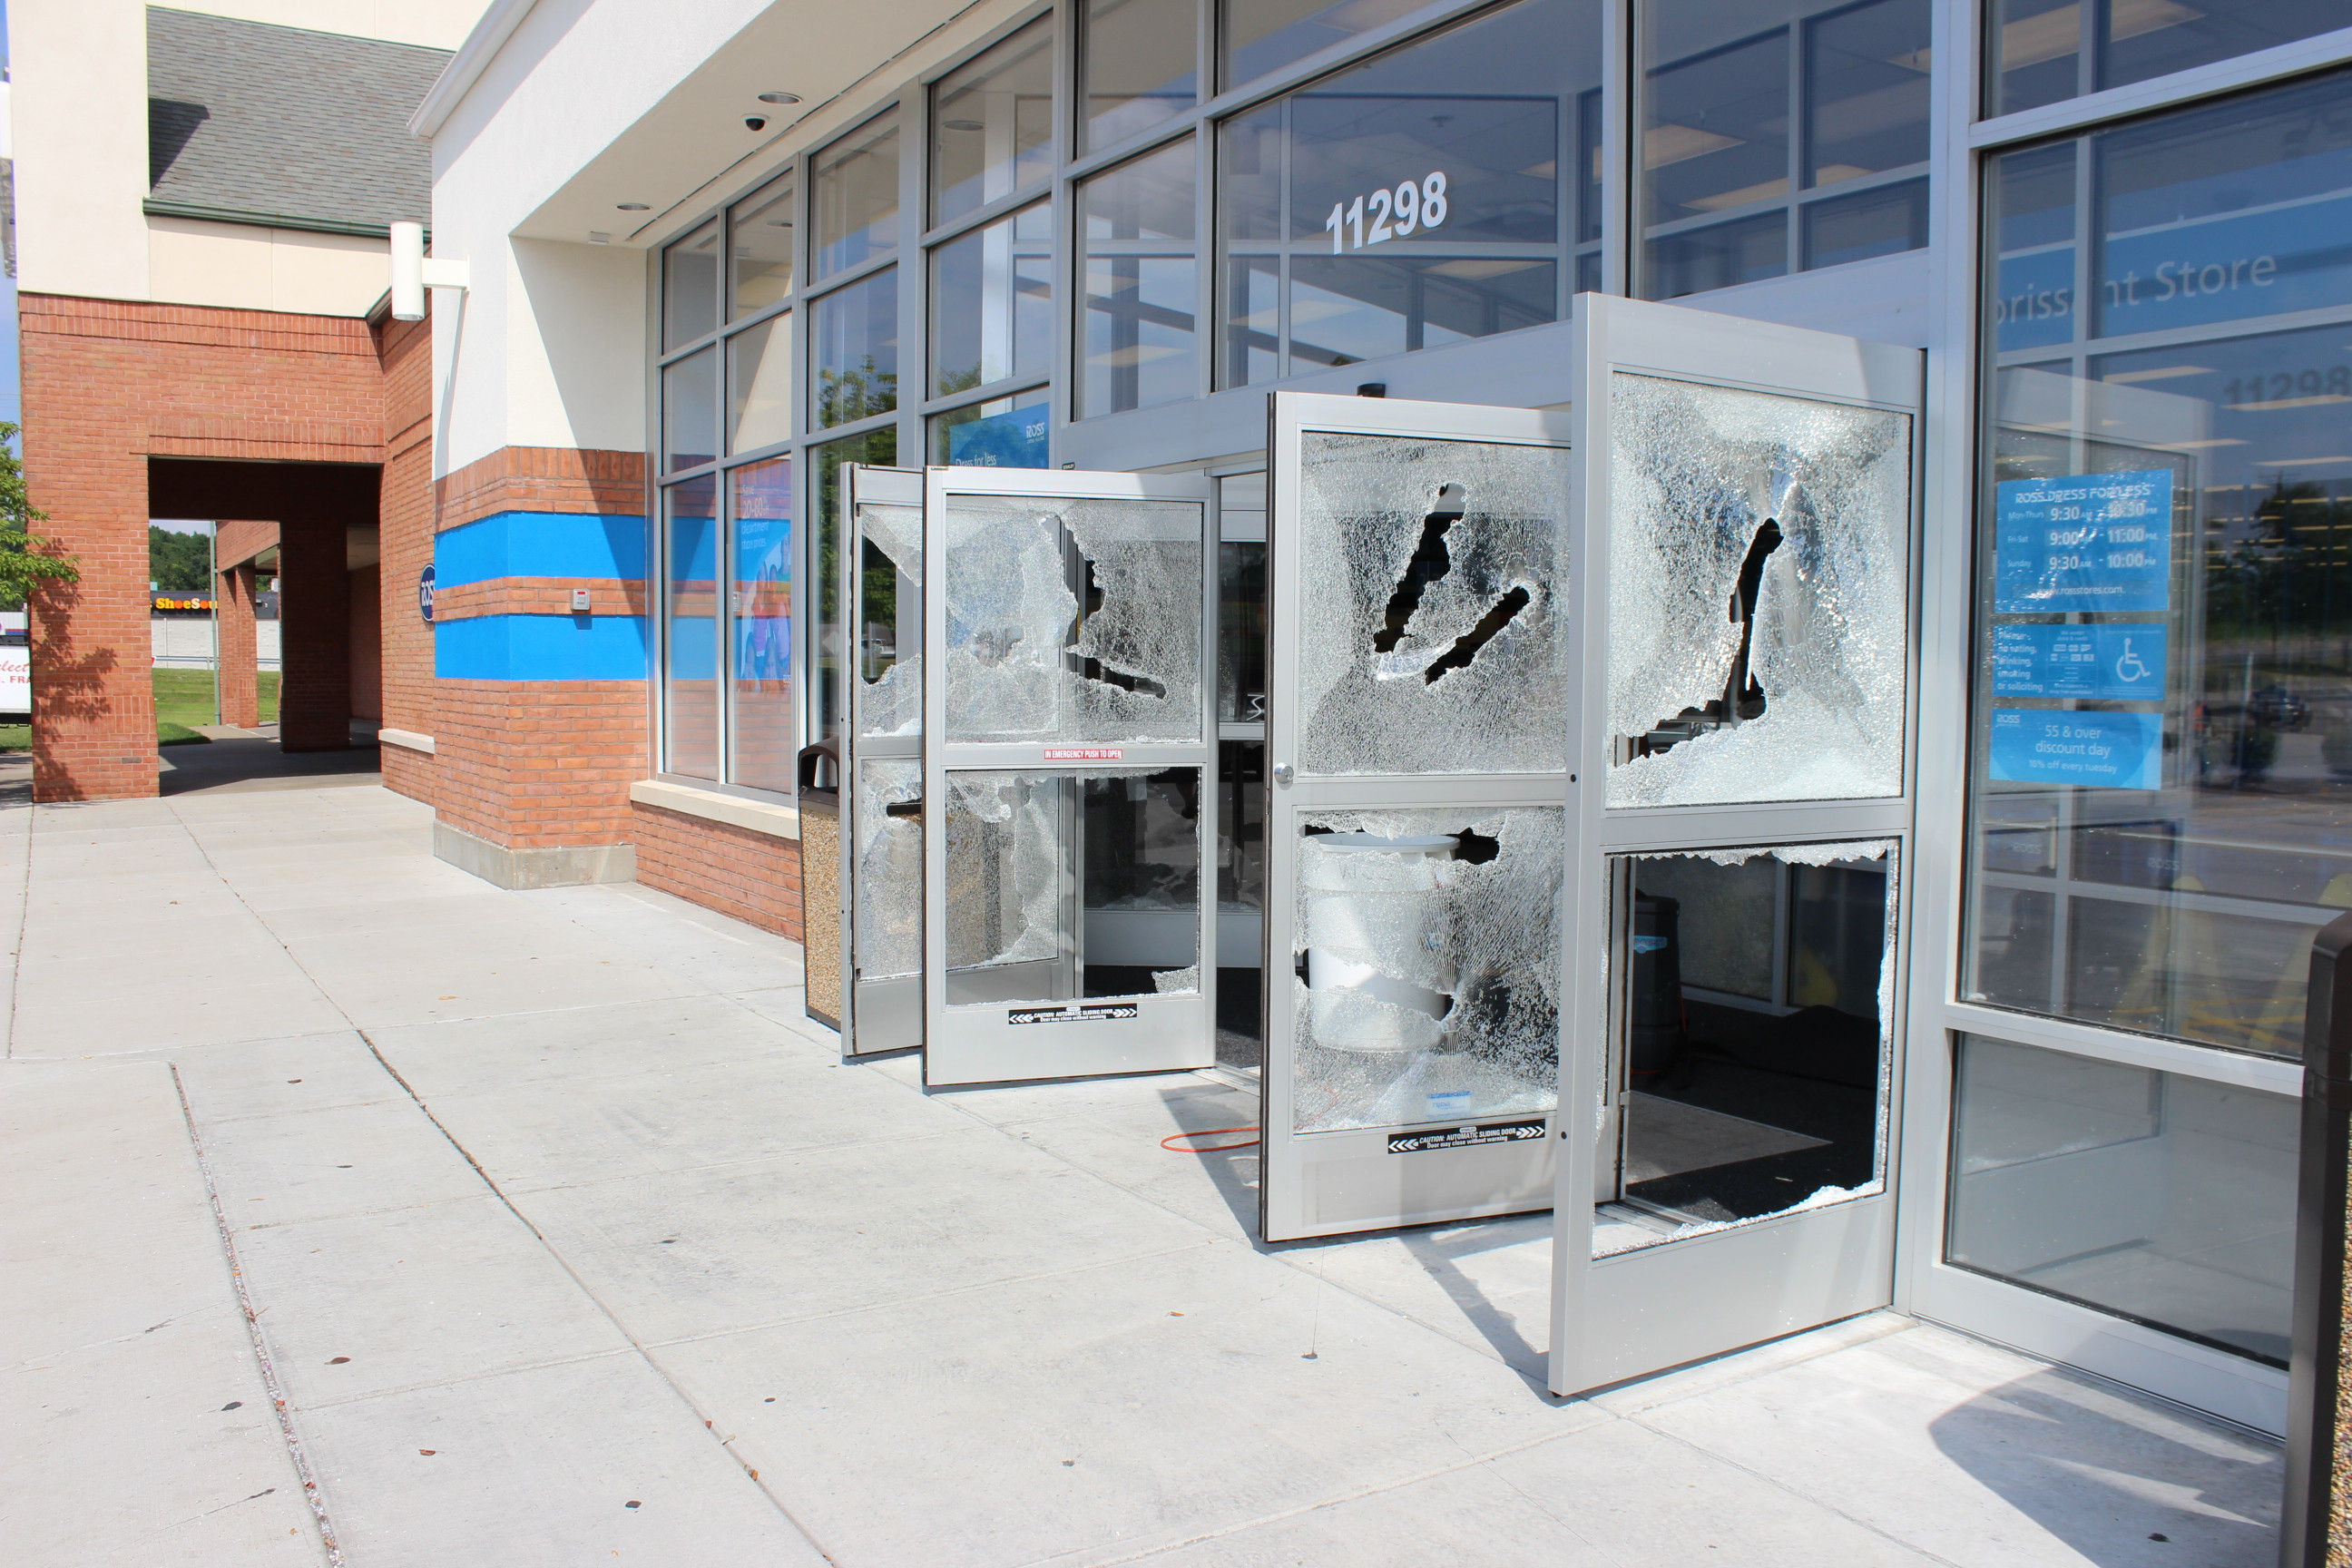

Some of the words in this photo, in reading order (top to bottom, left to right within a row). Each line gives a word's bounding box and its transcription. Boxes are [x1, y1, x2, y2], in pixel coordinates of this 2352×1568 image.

[1326, 171, 1447, 255] 11298
[2156, 254, 2277, 302] Store
[1026, 422, 1044, 438] ROSS
[985, 452, 997, 466] less
[2016, 491, 2044, 503] ROSS
[2049, 489, 2086, 502] DRESS
[2051, 507, 2080, 521] 9:30
[2050, 532, 2080, 545] 9:00
[2108, 528, 2145, 543] 11:00
[2007, 560, 2031, 568] Sunday
[2050, 556, 2079, 570] 9:30
[2107, 554, 2144, 568] 10:00
[2008, 682, 2043, 693] soliciting
[1997, 714, 2021, 724] ROSS
[2045, 725, 2060, 737] 55
[2063, 726, 2072, 738] &
[2075, 728, 2102, 739] over
[1053, 750, 1084, 759] EMERGENCY
[1085, 750, 1100, 759] PUSH
[1108, 750, 1122, 760] OPEN
[2035, 740, 2086, 755] discount
[2088, 743, 2112, 759] day
[1446, 1132, 1478, 1141] AUTOMATIC
